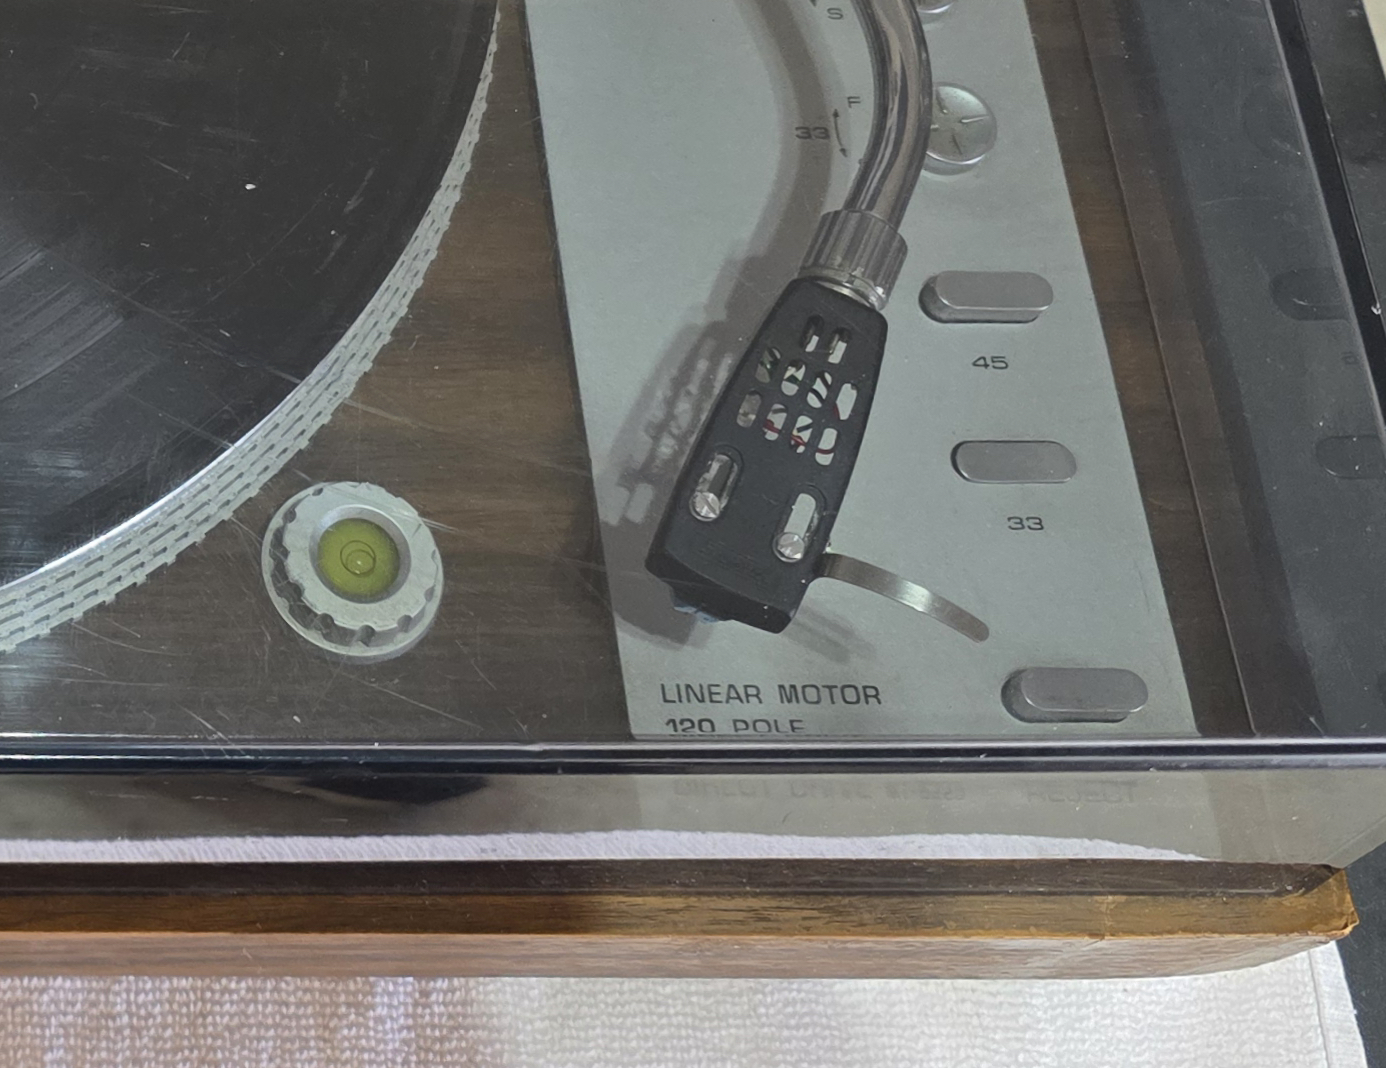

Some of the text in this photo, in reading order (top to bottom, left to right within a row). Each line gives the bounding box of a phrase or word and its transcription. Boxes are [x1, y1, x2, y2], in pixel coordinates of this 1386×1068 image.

[826, 7, 844, 20] S
[847, 96, 861, 109] F
[795, 126, 831, 140] 33
[971, 355, 1009, 370] 45
[1007, 516, 1044, 531] 33
[661, 683, 882, 705] LINEAR MOTOR
[666, 718, 715, 733] 120
